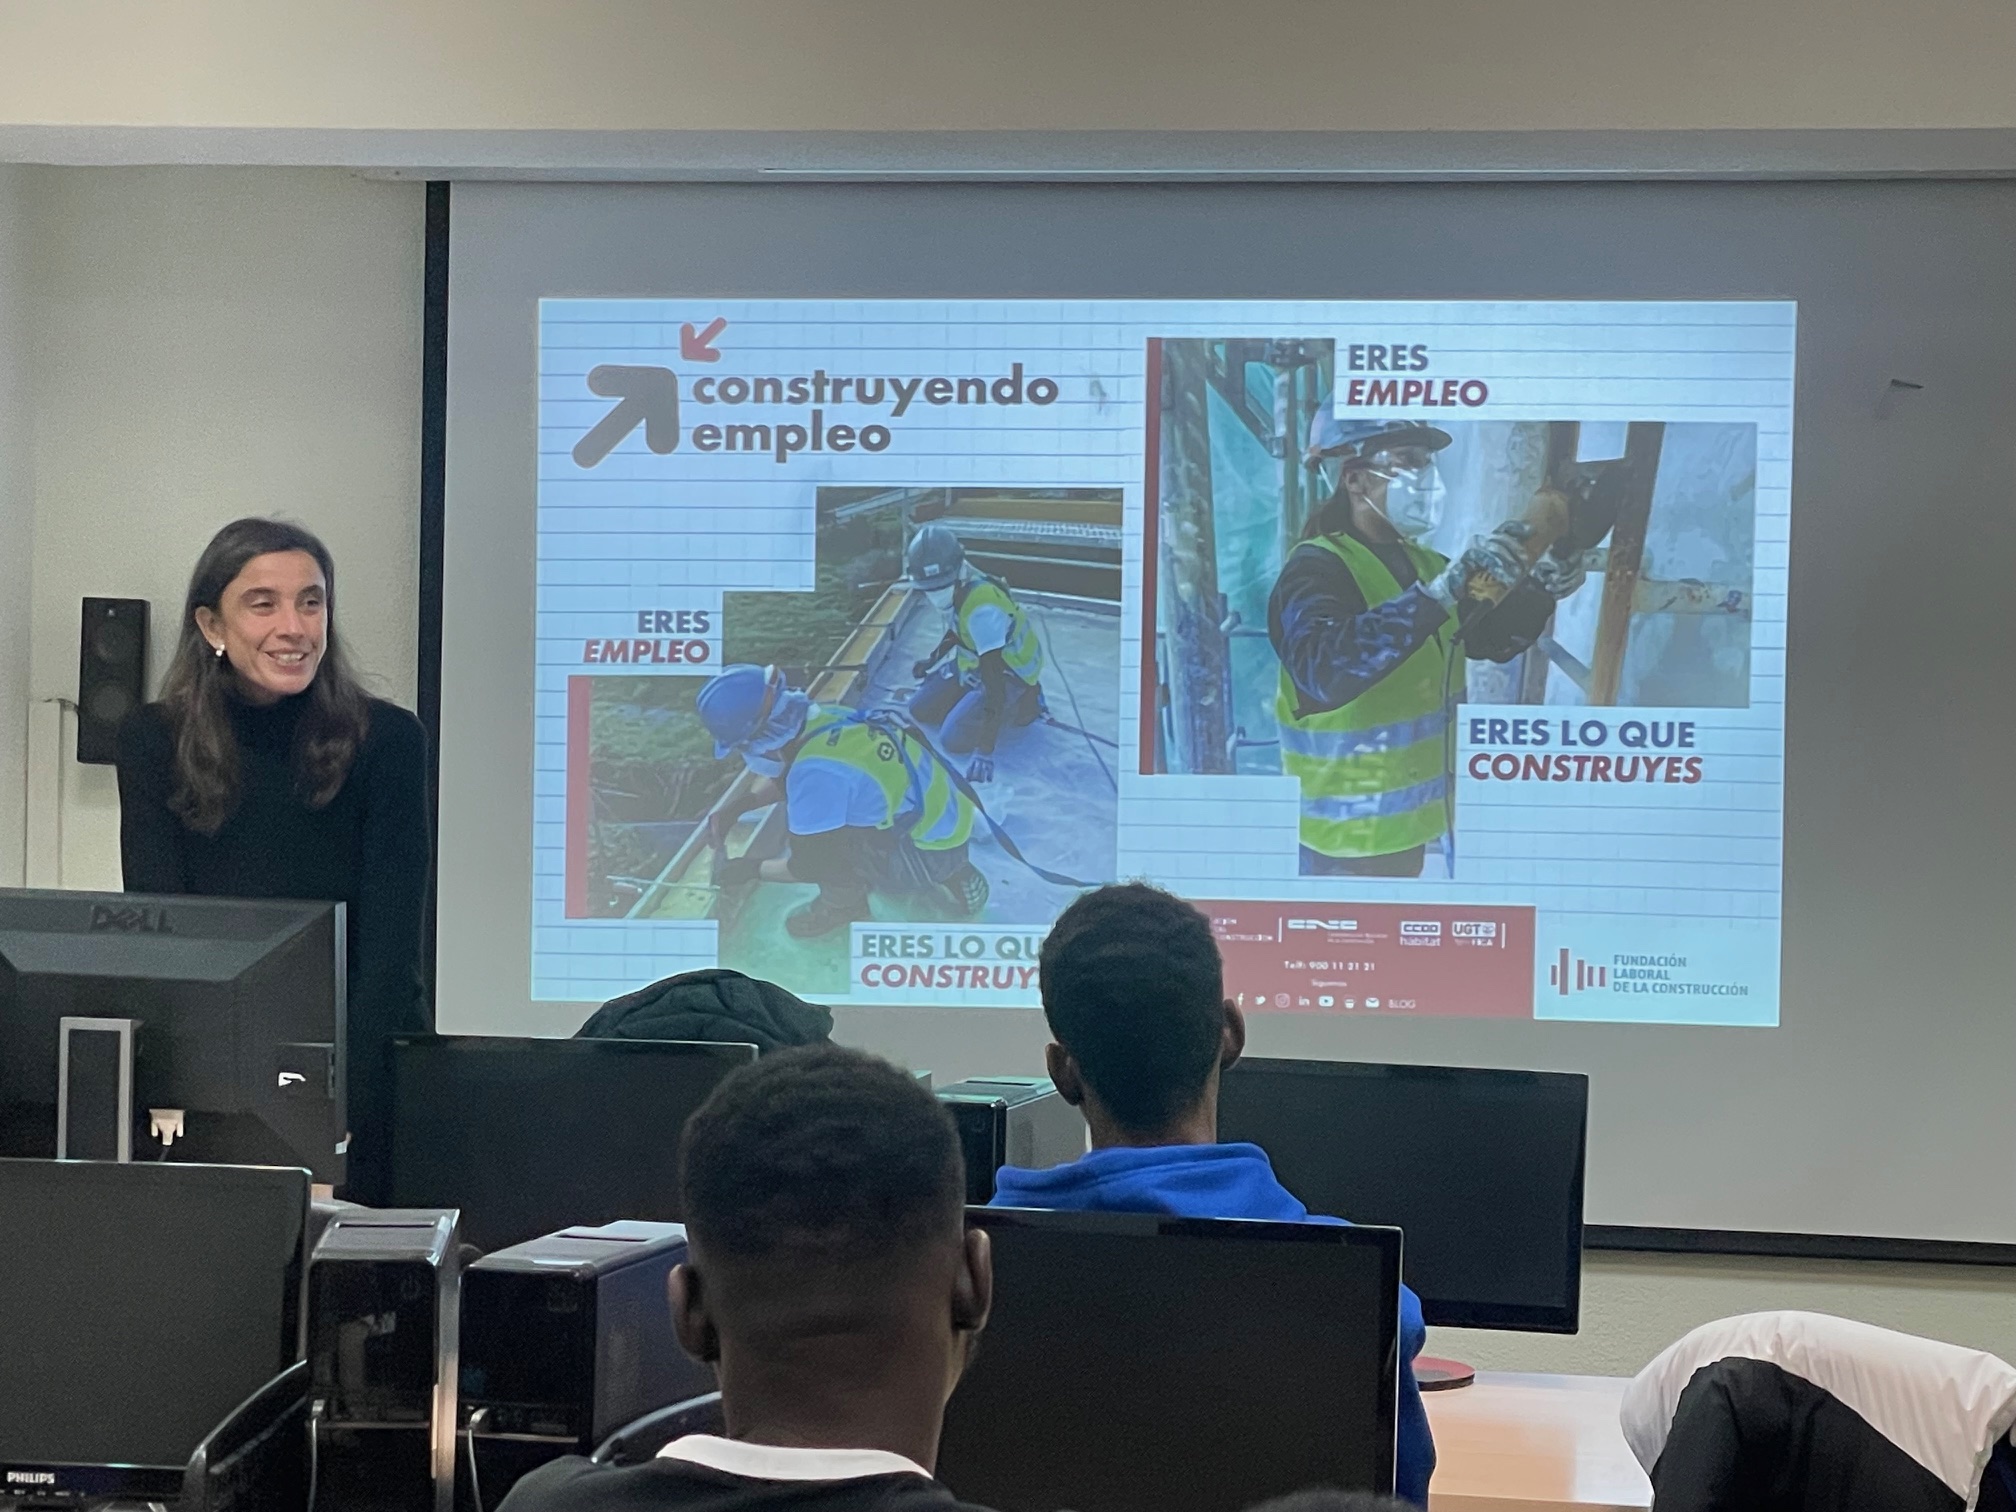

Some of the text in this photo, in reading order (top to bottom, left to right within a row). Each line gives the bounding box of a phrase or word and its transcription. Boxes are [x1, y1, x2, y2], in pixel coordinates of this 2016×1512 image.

[1347, 344, 1429, 371] ERES
[693, 363, 1059, 417] construyendo
[1346, 379, 1489, 407] EMPLEO
[692, 410, 891, 463] empleo
[637, 610, 710, 634] ERES
[583, 639, 710, 663] EMPLEO
[1469, 718, 1695, 749] ERES LO QUE
[1468, 753, 1703, 784] CONSTRUYES
[1453, 923, 1482, 935] UGT
[862, 934, 1041, 960] ERES LO QU
[1309, 961, 1329, 970] 900
[1613, 953, 1687, 967] FUNDACIÓN
[861, 963, 1039, 989] CONSTRUY
[1613, 968, 1671, 980] LABORAL
[1613, 981, 1749, 996] DE LA CONSTRUCCIÓN
[1388, 999, 1416, 1009] BLOG
[7, 1471, 55, 1484] PHILIPS
